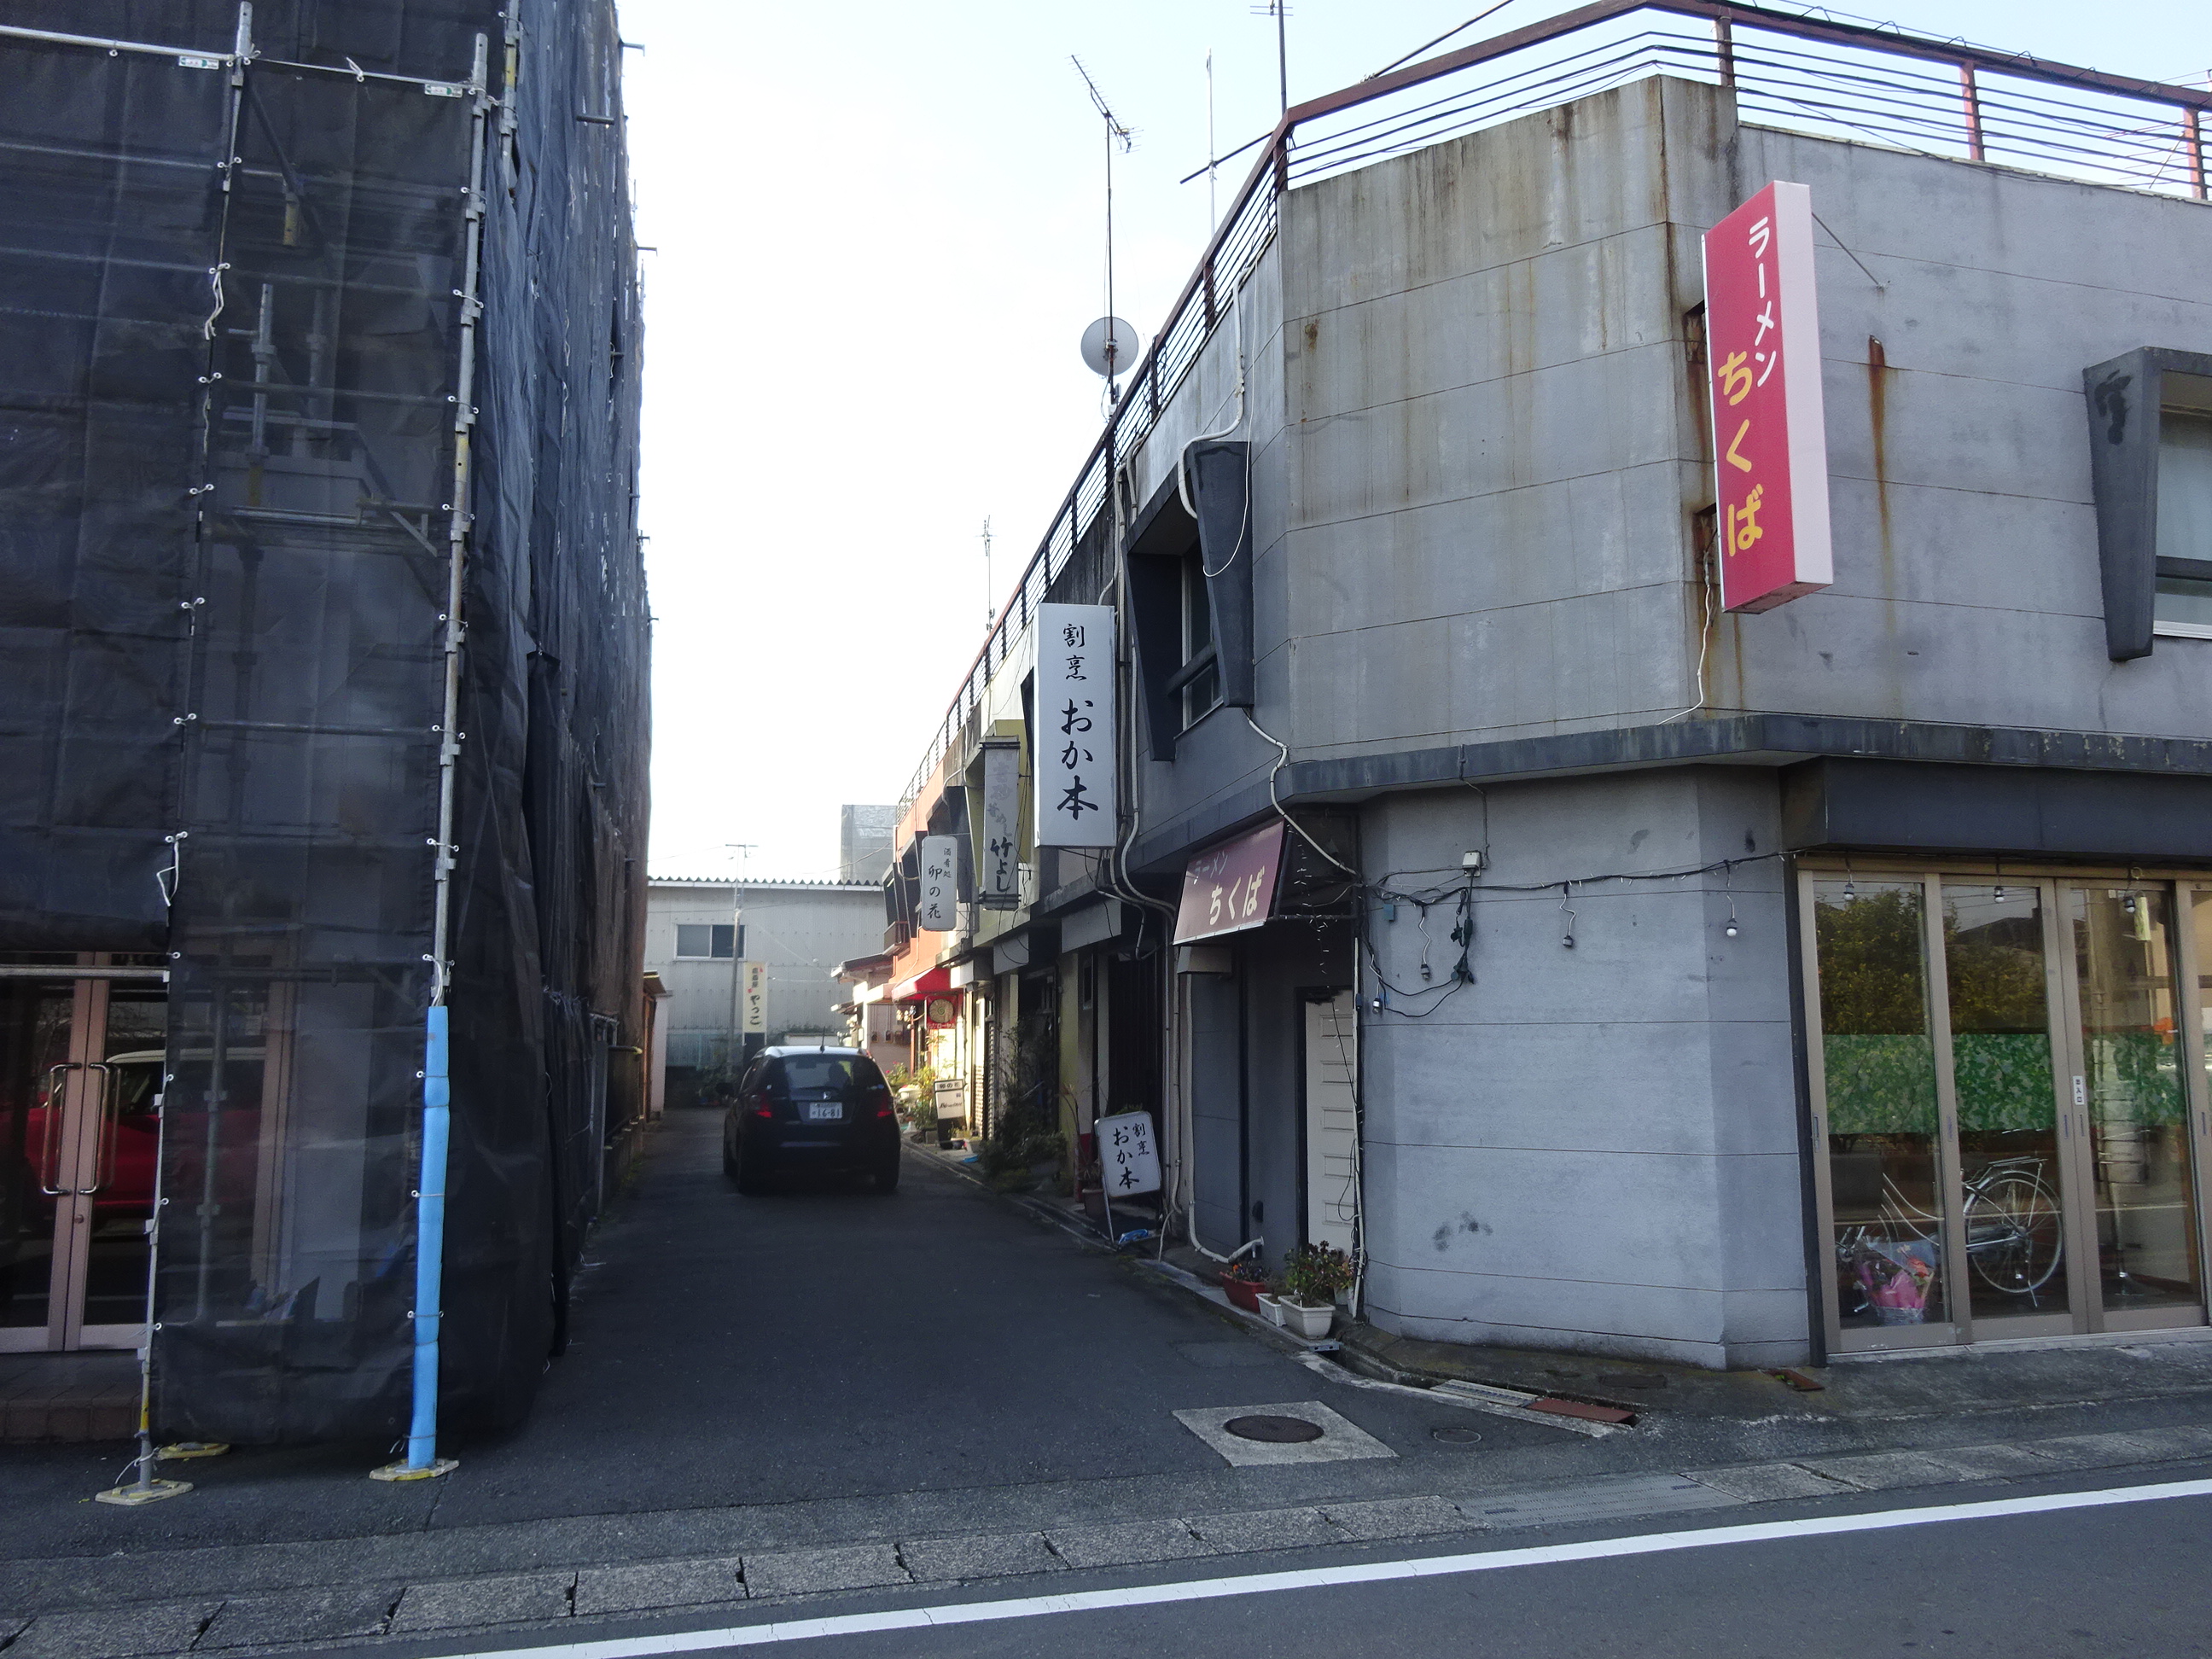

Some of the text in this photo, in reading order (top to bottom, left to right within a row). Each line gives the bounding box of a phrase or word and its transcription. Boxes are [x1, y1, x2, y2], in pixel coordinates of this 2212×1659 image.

[1749, 216, 1777, 387] ラーメン
[1718, 351, 1764, 557] ちくば
[1057, 623, 1099, 821] 割烹 おか本
[927, 864, 943, 919] 卯の花
[990, 836, 1014, 893] 竹よし
[1194, 849, 1228, 885] ラーメン
[1209, 864, 1265, 926] ちくば
[1113, 1126, 1140, 1190] おか本
[1132, 1122, 1150, 1156] 割烹
